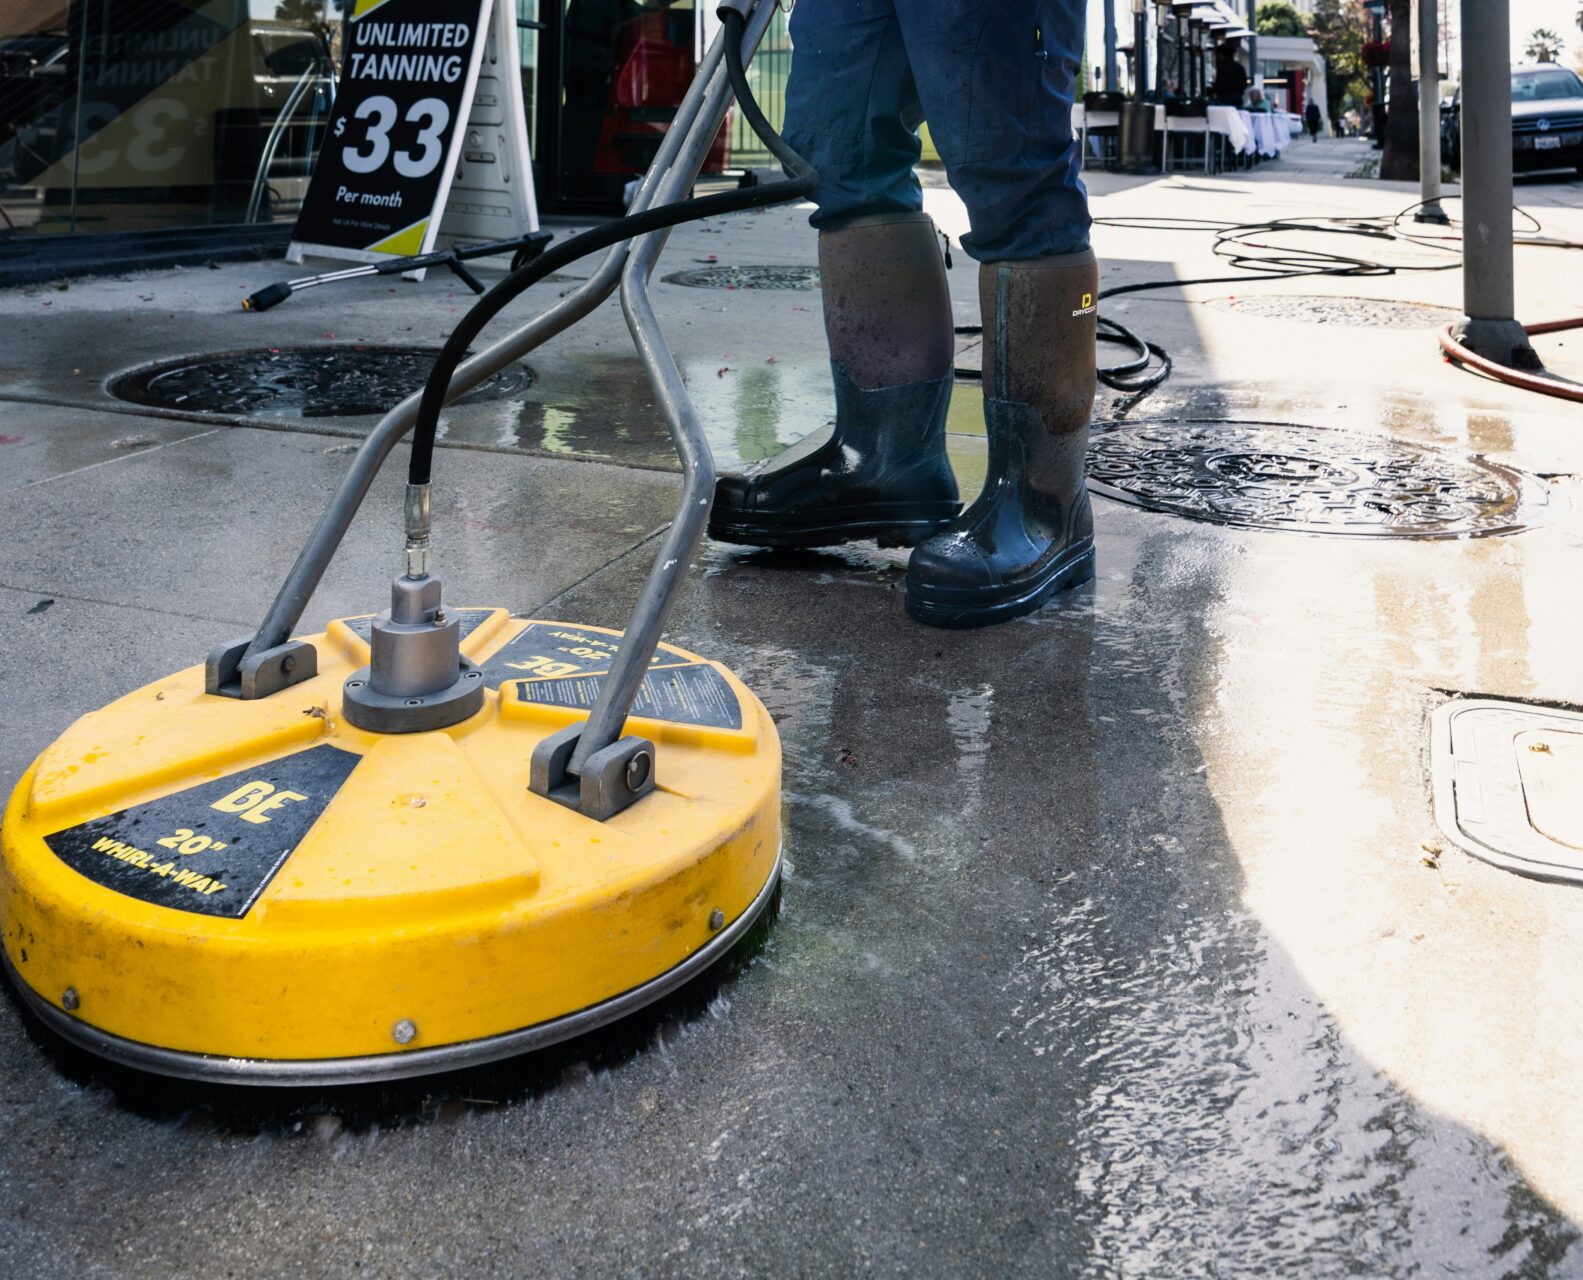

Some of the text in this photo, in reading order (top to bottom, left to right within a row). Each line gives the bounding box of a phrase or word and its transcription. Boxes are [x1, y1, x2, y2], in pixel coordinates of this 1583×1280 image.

[356, 22, 470, 48] UNLIMITED
[351, 53, 462, 83] TANNING
[336, 185, 403, 208] Per month
[504, 655, 582, 677] BE
[209, 780, 309, 824] BE
[156, 828, 228, 855] 20"
[90, 836, 228, 896] WHIRL-A-WAY
